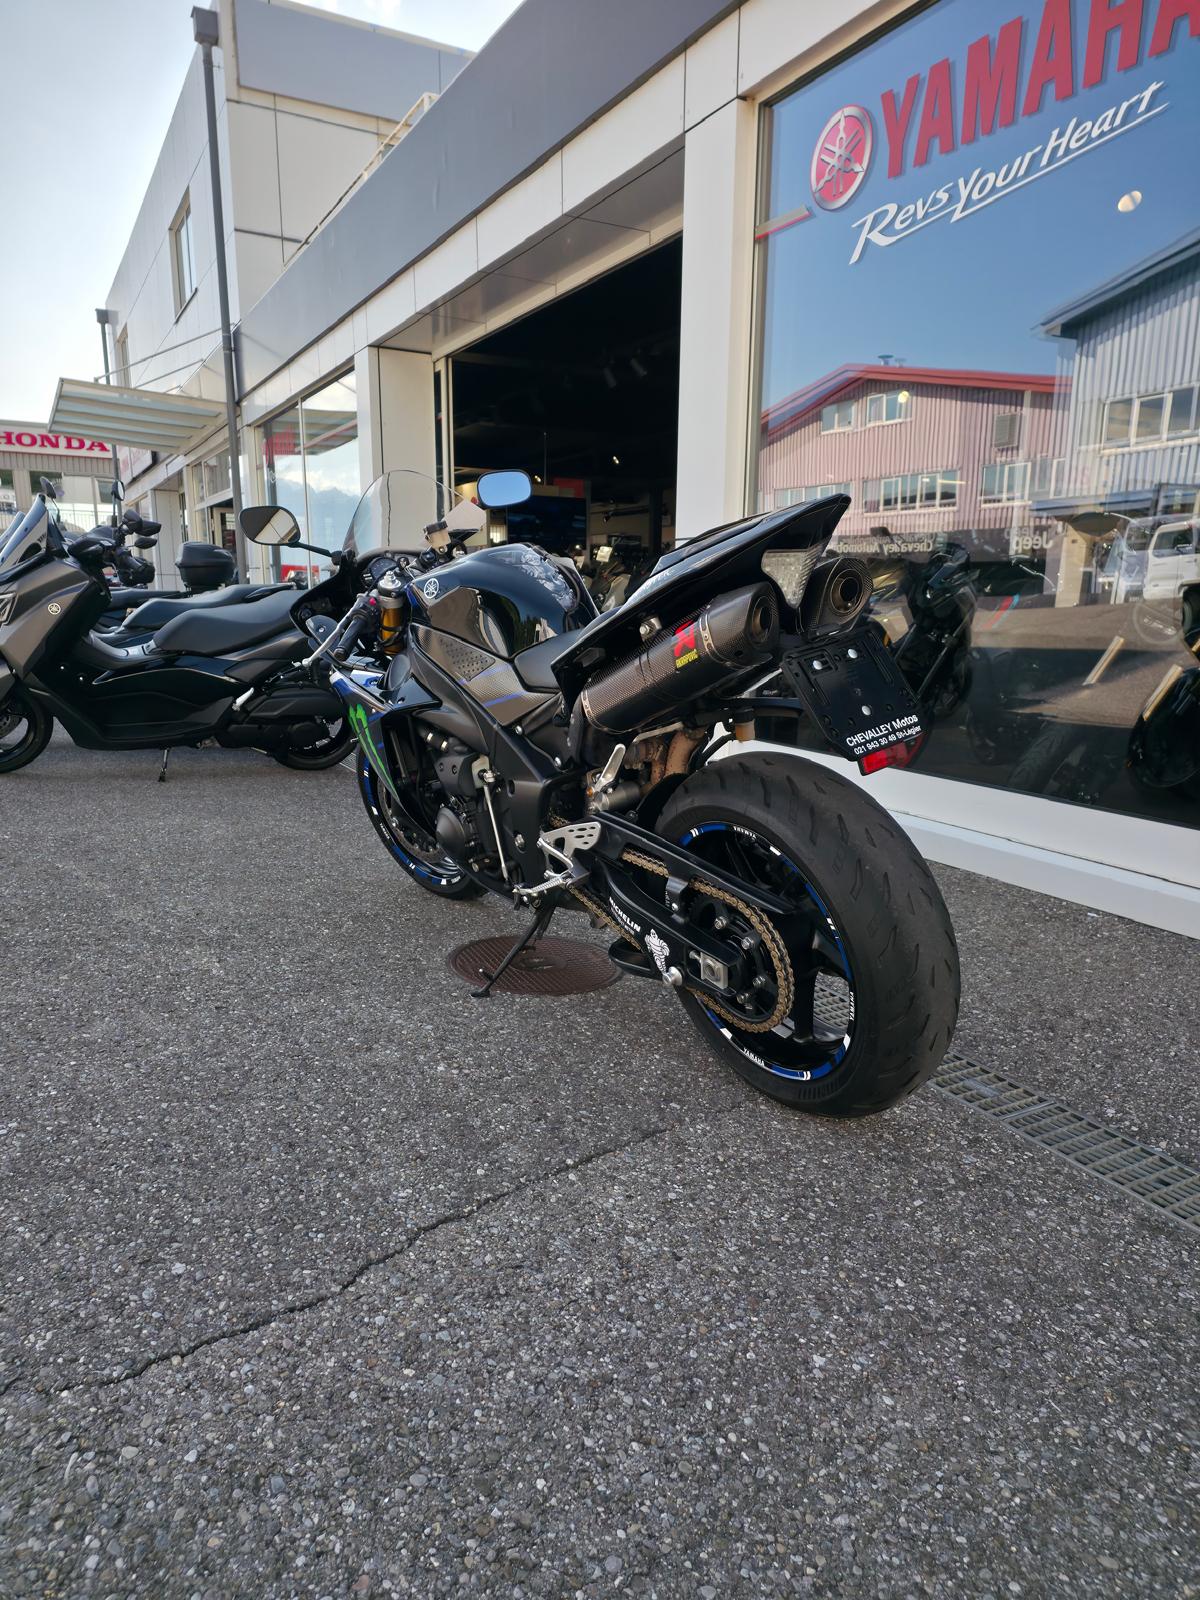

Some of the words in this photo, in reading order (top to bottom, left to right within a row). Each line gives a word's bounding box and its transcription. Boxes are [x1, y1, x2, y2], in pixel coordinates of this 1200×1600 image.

[848, 182, 954, 264] Revs
[951, 145, 1042, 223] Your
[1039, 80, 1165, 168] Heart
[0, 431, 110, 452] HONDA
[846, 722, 892, 747] CHEVALLEY
[892, 714, 919, 730] Motos
[853, 746, 867, 755] 021
[866, 741, 880, 750] 943
[879, 738, 888, 746] 30
